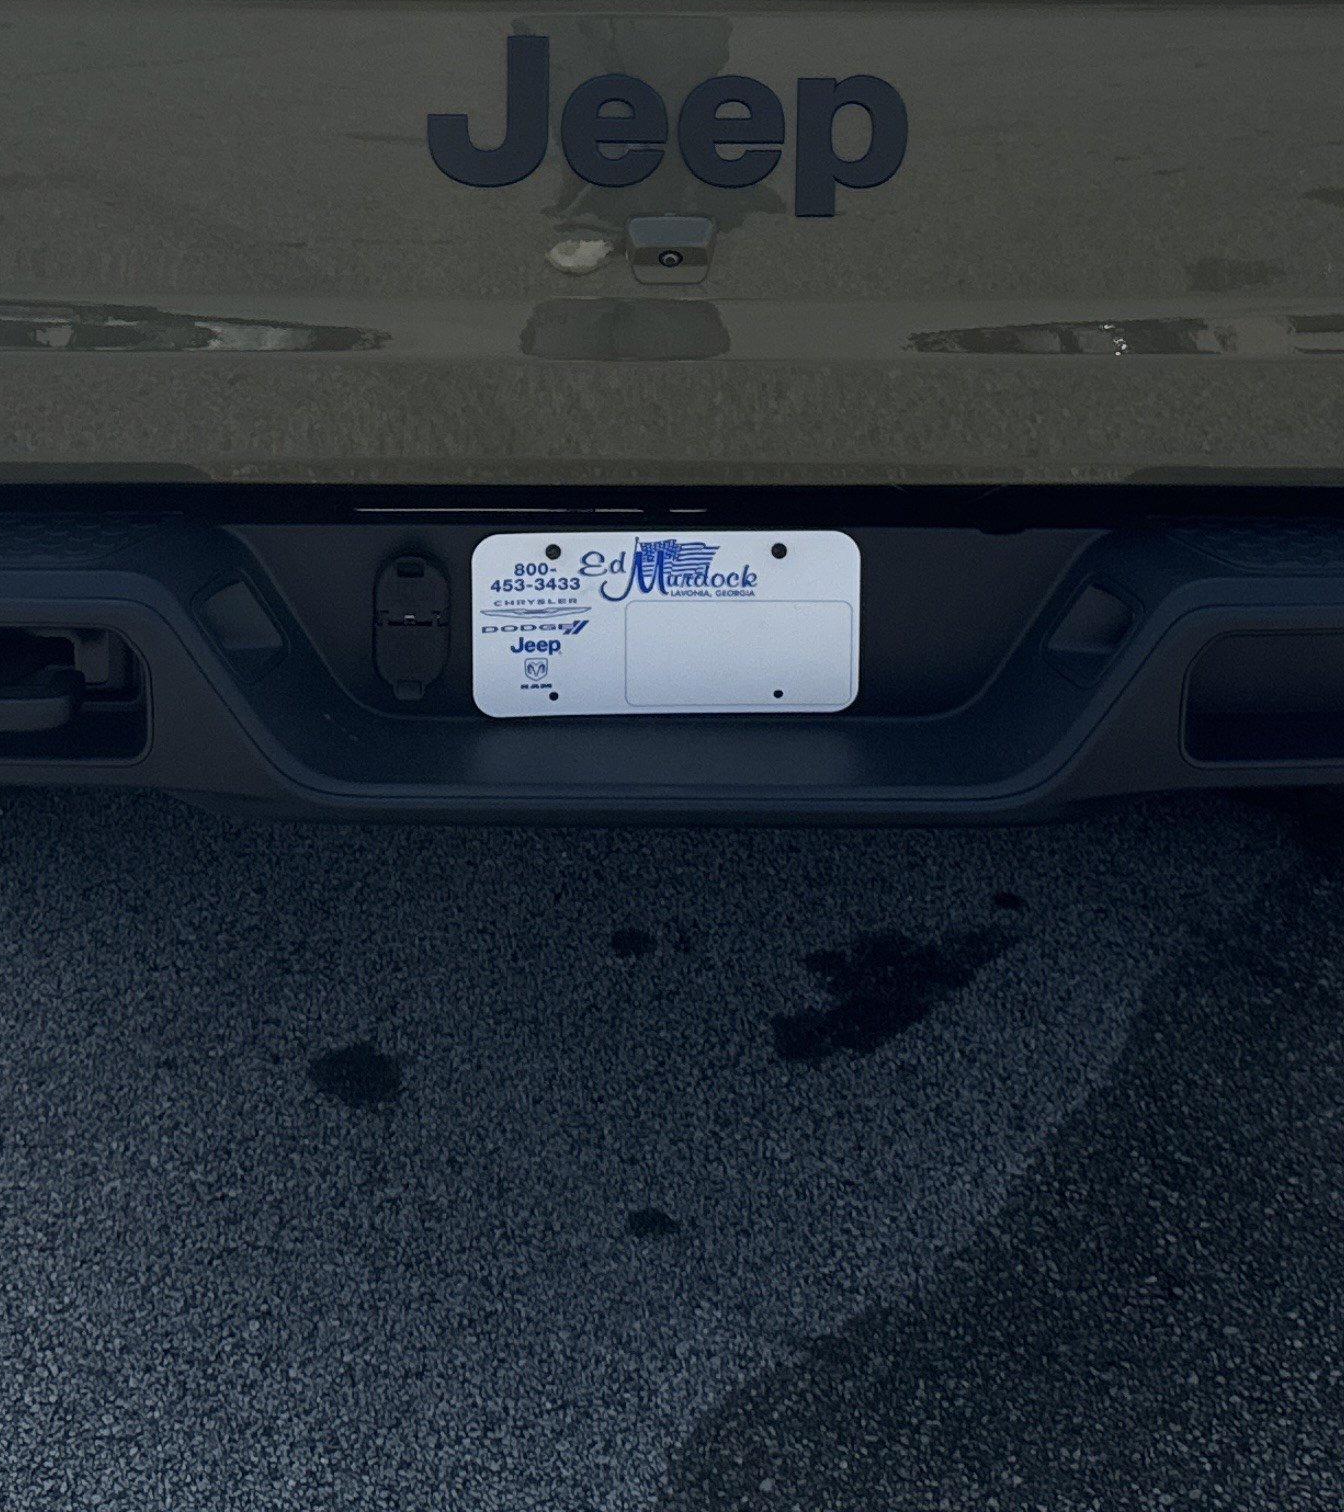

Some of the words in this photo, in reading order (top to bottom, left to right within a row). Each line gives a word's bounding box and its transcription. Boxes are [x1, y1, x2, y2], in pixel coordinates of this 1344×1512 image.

[427, 35, 908, 217] Jeep
[513, 562, 558, 576] 800-
[578, 550, 626, 577] Ed
[599, 548, 758, 602] Murdock
[490, 577, 581, 592] 453-3433
[670, 589, 712, 597] LAVONIA,
[715, 589, 755, 597] GEORGIA
[494, 598, 578, 607] CHRYSLER
[481, 623, 576, 634] DODGE
[510, 636, 561, 656] Jeep
